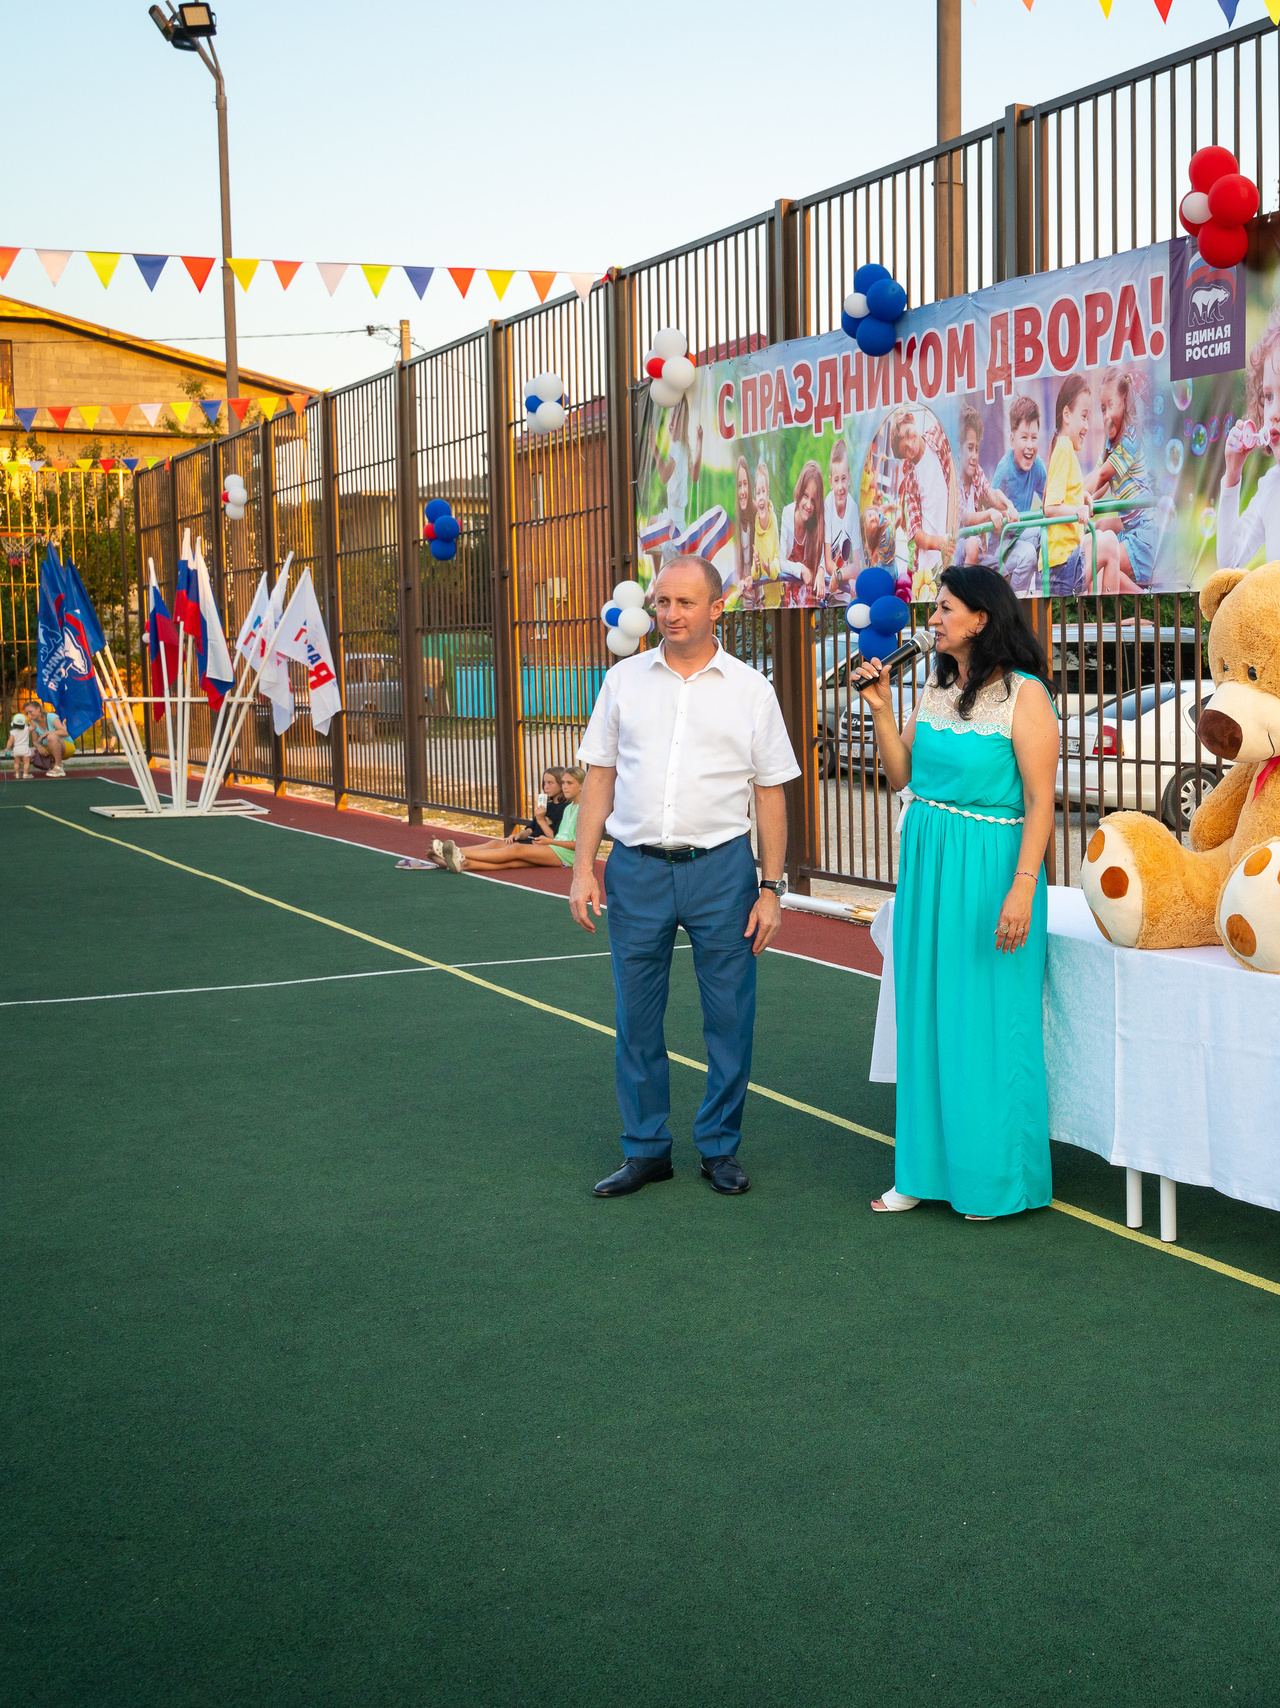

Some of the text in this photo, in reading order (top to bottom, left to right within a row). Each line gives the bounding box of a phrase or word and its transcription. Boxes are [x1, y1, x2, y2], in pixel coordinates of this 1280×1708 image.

[1185, 324, 1231, 346] ЕДИНАЯ
[717, 274, 1166, 441] С ПРАЗДНИКОМ ДВОРА!
[1185, 341, 1231, 362] РОССИЯ
